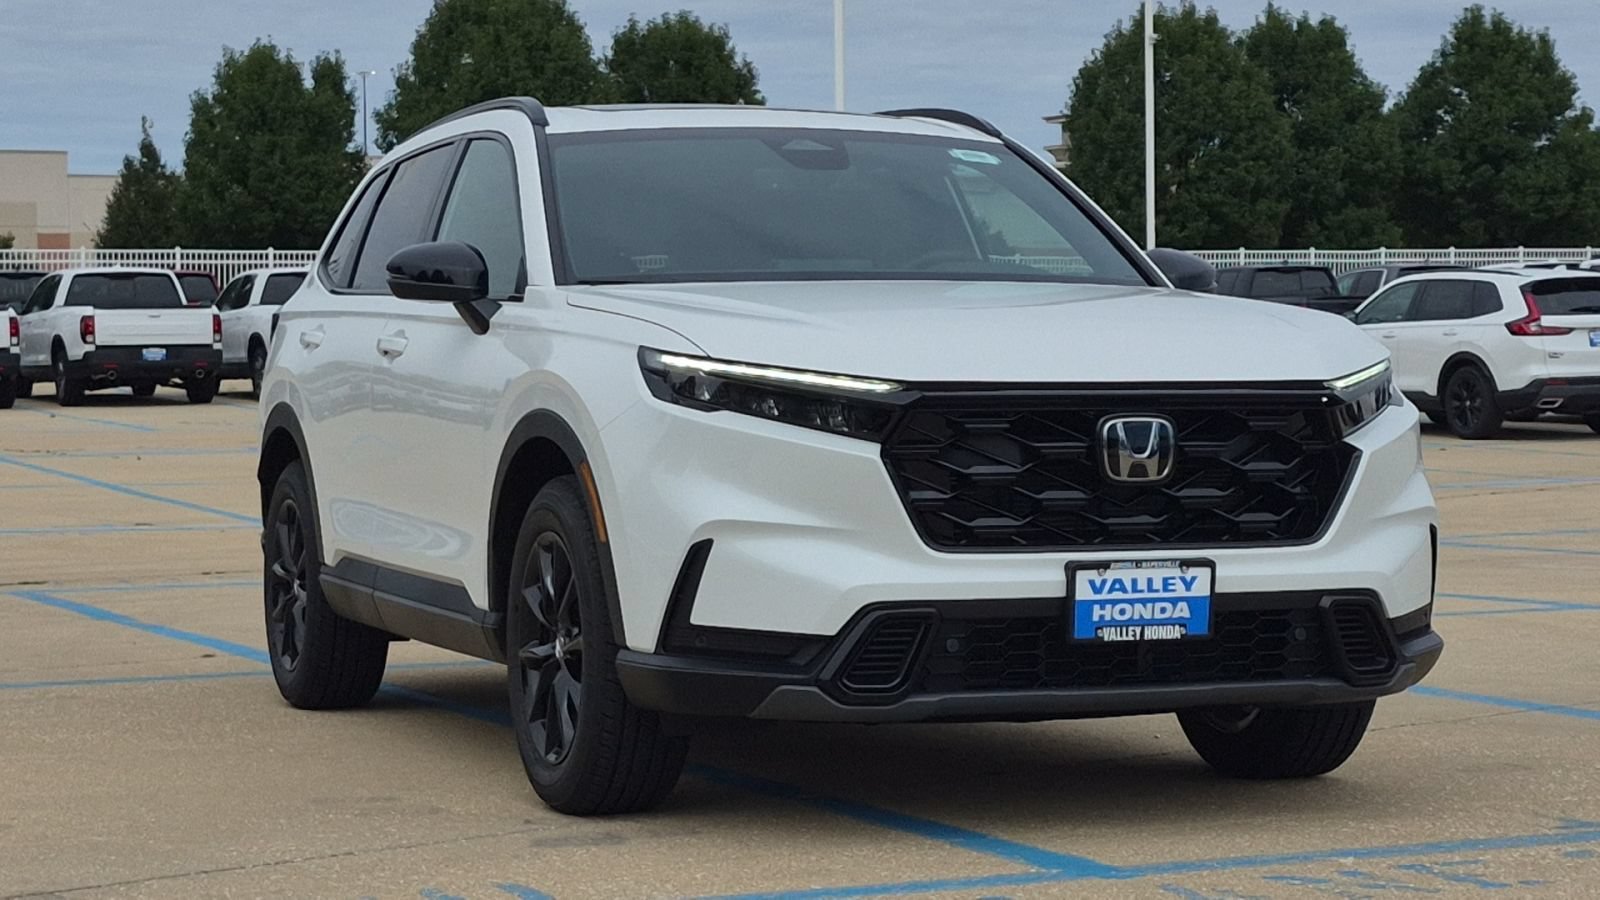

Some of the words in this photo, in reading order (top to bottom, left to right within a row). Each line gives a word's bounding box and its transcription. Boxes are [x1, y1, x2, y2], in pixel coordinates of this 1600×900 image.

[1088, 576, 1198, 595] VALLEY
[1092, 601, 1191, 621] HONDA
[1103, 626, 1141, 641] VALLEY
[1144, 624, 1181, 639] HONDA
